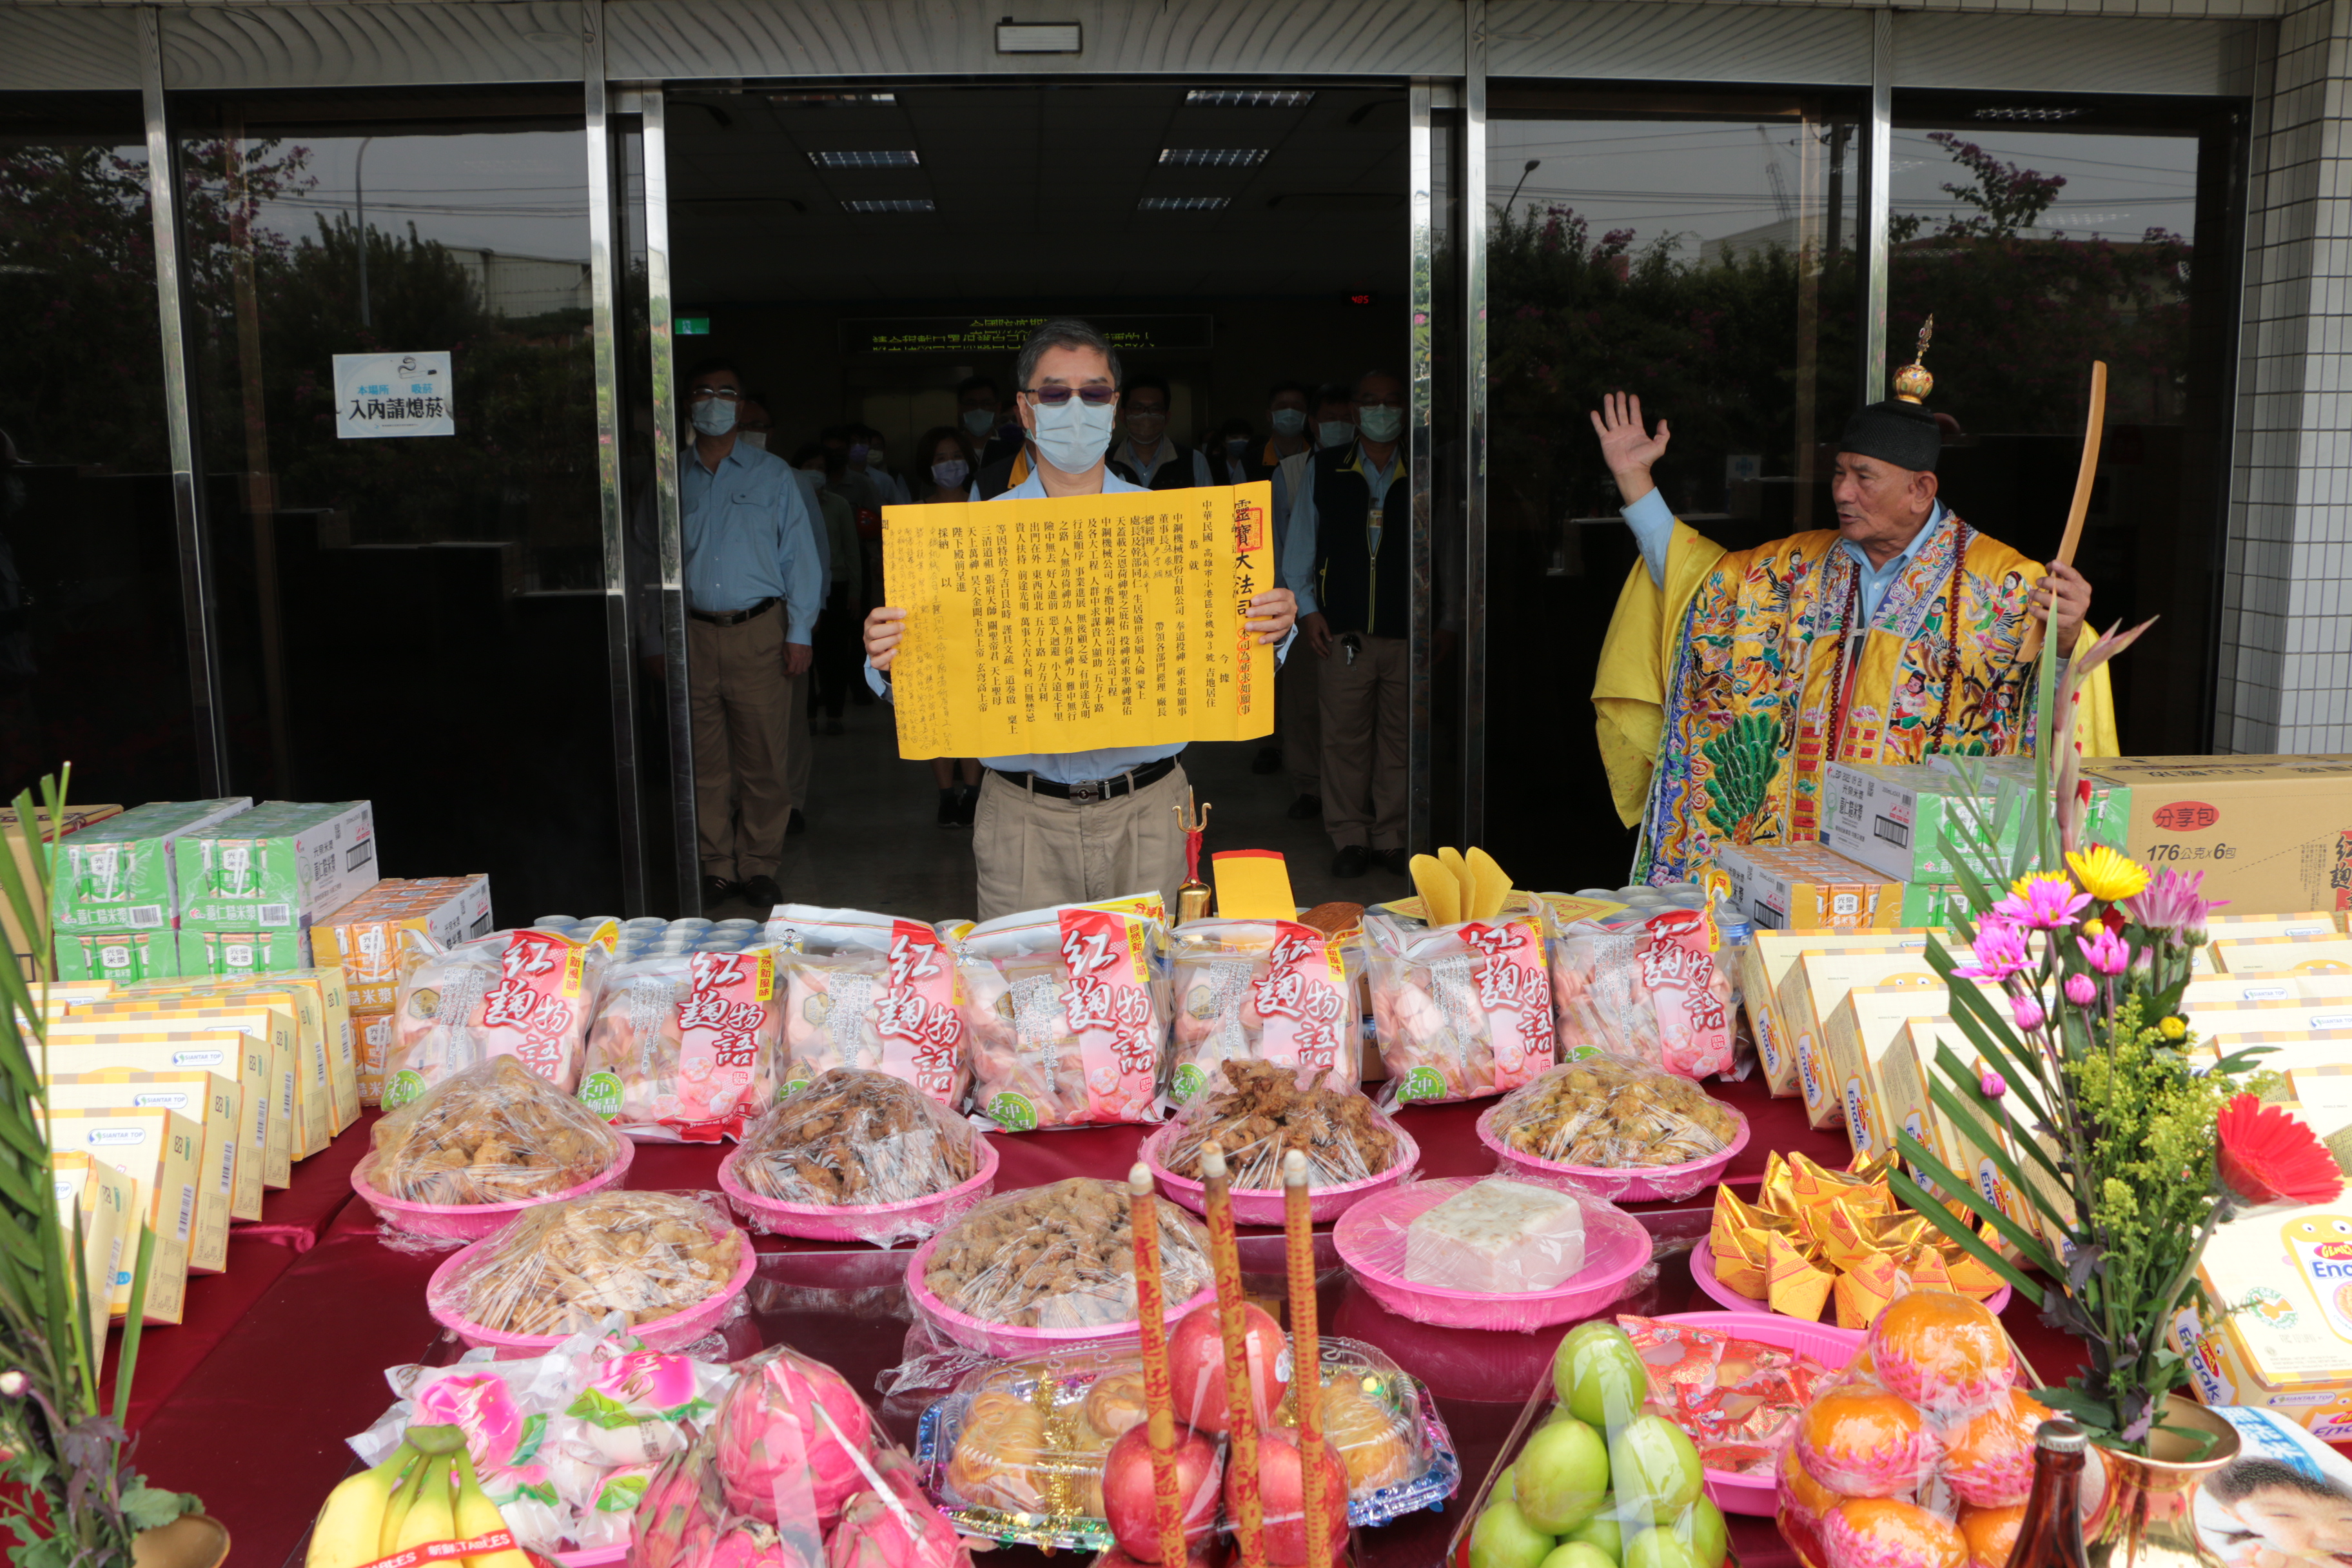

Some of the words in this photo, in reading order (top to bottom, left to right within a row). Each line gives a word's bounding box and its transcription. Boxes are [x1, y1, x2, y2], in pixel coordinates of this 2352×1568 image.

[349, 397, 444, 420] 入內請熄菸
[357, 385, 389, 396] 本場所
[938, 527, 949, 549] 採納
[1044, 521, 1055, 563] 險中無去
[1073, 519, 1084, 561] 行途順序
[1145, 515, 1155, 546] 總經理
[1159, 514, 1169, 545] 董事長
[1202, 500, 1213, 542] 中華民國
[952, 527, 966, 593] 陛下殿前呈進
[968, 527, 979, 570] 天上萬神
[982, 526, 994, 569] 三清道祖
[1015, 522, 1026, 565] 貴人扶持
[1030, 522, 1041, 564] 出門在外
[1088, 518, 1098, 571] 及各大工程
[1101, 516, 1113, 579] 中鋼機械公司
[1173, 513, 1184, 616] 中鋼機械股份有限公司
[941, 577, 952, 588] 以
[995, 524, 1011, 619] 等因特於今吉日良時
[1018, 571, 1029, 611] 前途光明
[1032, 570, 1043, 611] 東西南北
[1046, 569, 1057, 610] 好人進前
[1075, 567, 1086, 608] 事業進展
[985, 574, 997, 616] 張府天師
[1130, 515, 1142, 588] 處長及幹部同仁
[1136, 680, 1146, 700] 蒙上
[1204, 549, 1215, 662] 高雄市小港區台機路3號
[988, 621, 999, 661] 關聖帝君
[1035, 616, 1046, 657] 五方十路
[1049, 616, 1060, 656] 惡人迴避
[1059, 521, 1068, 542] 之路
[1066, 681, 1077, 721] 難中無行
[1077, 614, 1088, 665] 無後顧之憂
[1090, 576, 1102, 668] 人群中求謀貴人顯助
[1104, 585, 1118, 696] 承攬中鋼公司母公司工程
[1176, 621, 1186, 662] 奉道投神
[1021, 617, 1032, 678] 萬事大吉大利
[1155, 622, 1166, 692] 帶領各部門經理
[990, 666, 1001, 705] 天上聖母
[1037, 662, 1048, 702] 方方吉利
[1051, 662, 1063, 721] 小人遠走千里
[1094, 673, 1104, 713] 五方十路
[1120, 636, 1132, 716] 投神祈求聖神護佑
[1177, 667, 1187, 716] 祈求如願事
[1206, 668, 1216, 708] 吉地居住
[1240, 629, 1251, 715] 本司為祈求如願事
[1024, 683, 1035, 722] 百無禁忌
[1079, 670, 1090, 720] 有前途光明
[1157, 698, 1166, 717] 廠長
[2155, 808, 2215, 828] 分享包
[1129, 923, 1146, 976] 自然新風味
[1112, 985, 1151, 1073] 物語
[1295, 980, 1341, 1065] 物語
[1518, 968, 1552, 1054] 物語
[518, 995, 571, 1077] 物語
[713, 1003, 765, 1064] 物語
[913, 1004, 962, 1090] 物語
[1759, 1020, 1775, 1067] Enaak
[357, 1081, 382, 1097] 糙米
[1799, 1046, 1815, 1099] Enaak
[1848, 1089, 1864, 1146] Enaak
[1981, 1171, 1996, 1209] Ena
[2179, 1327, 2220, 1400] Eaak
